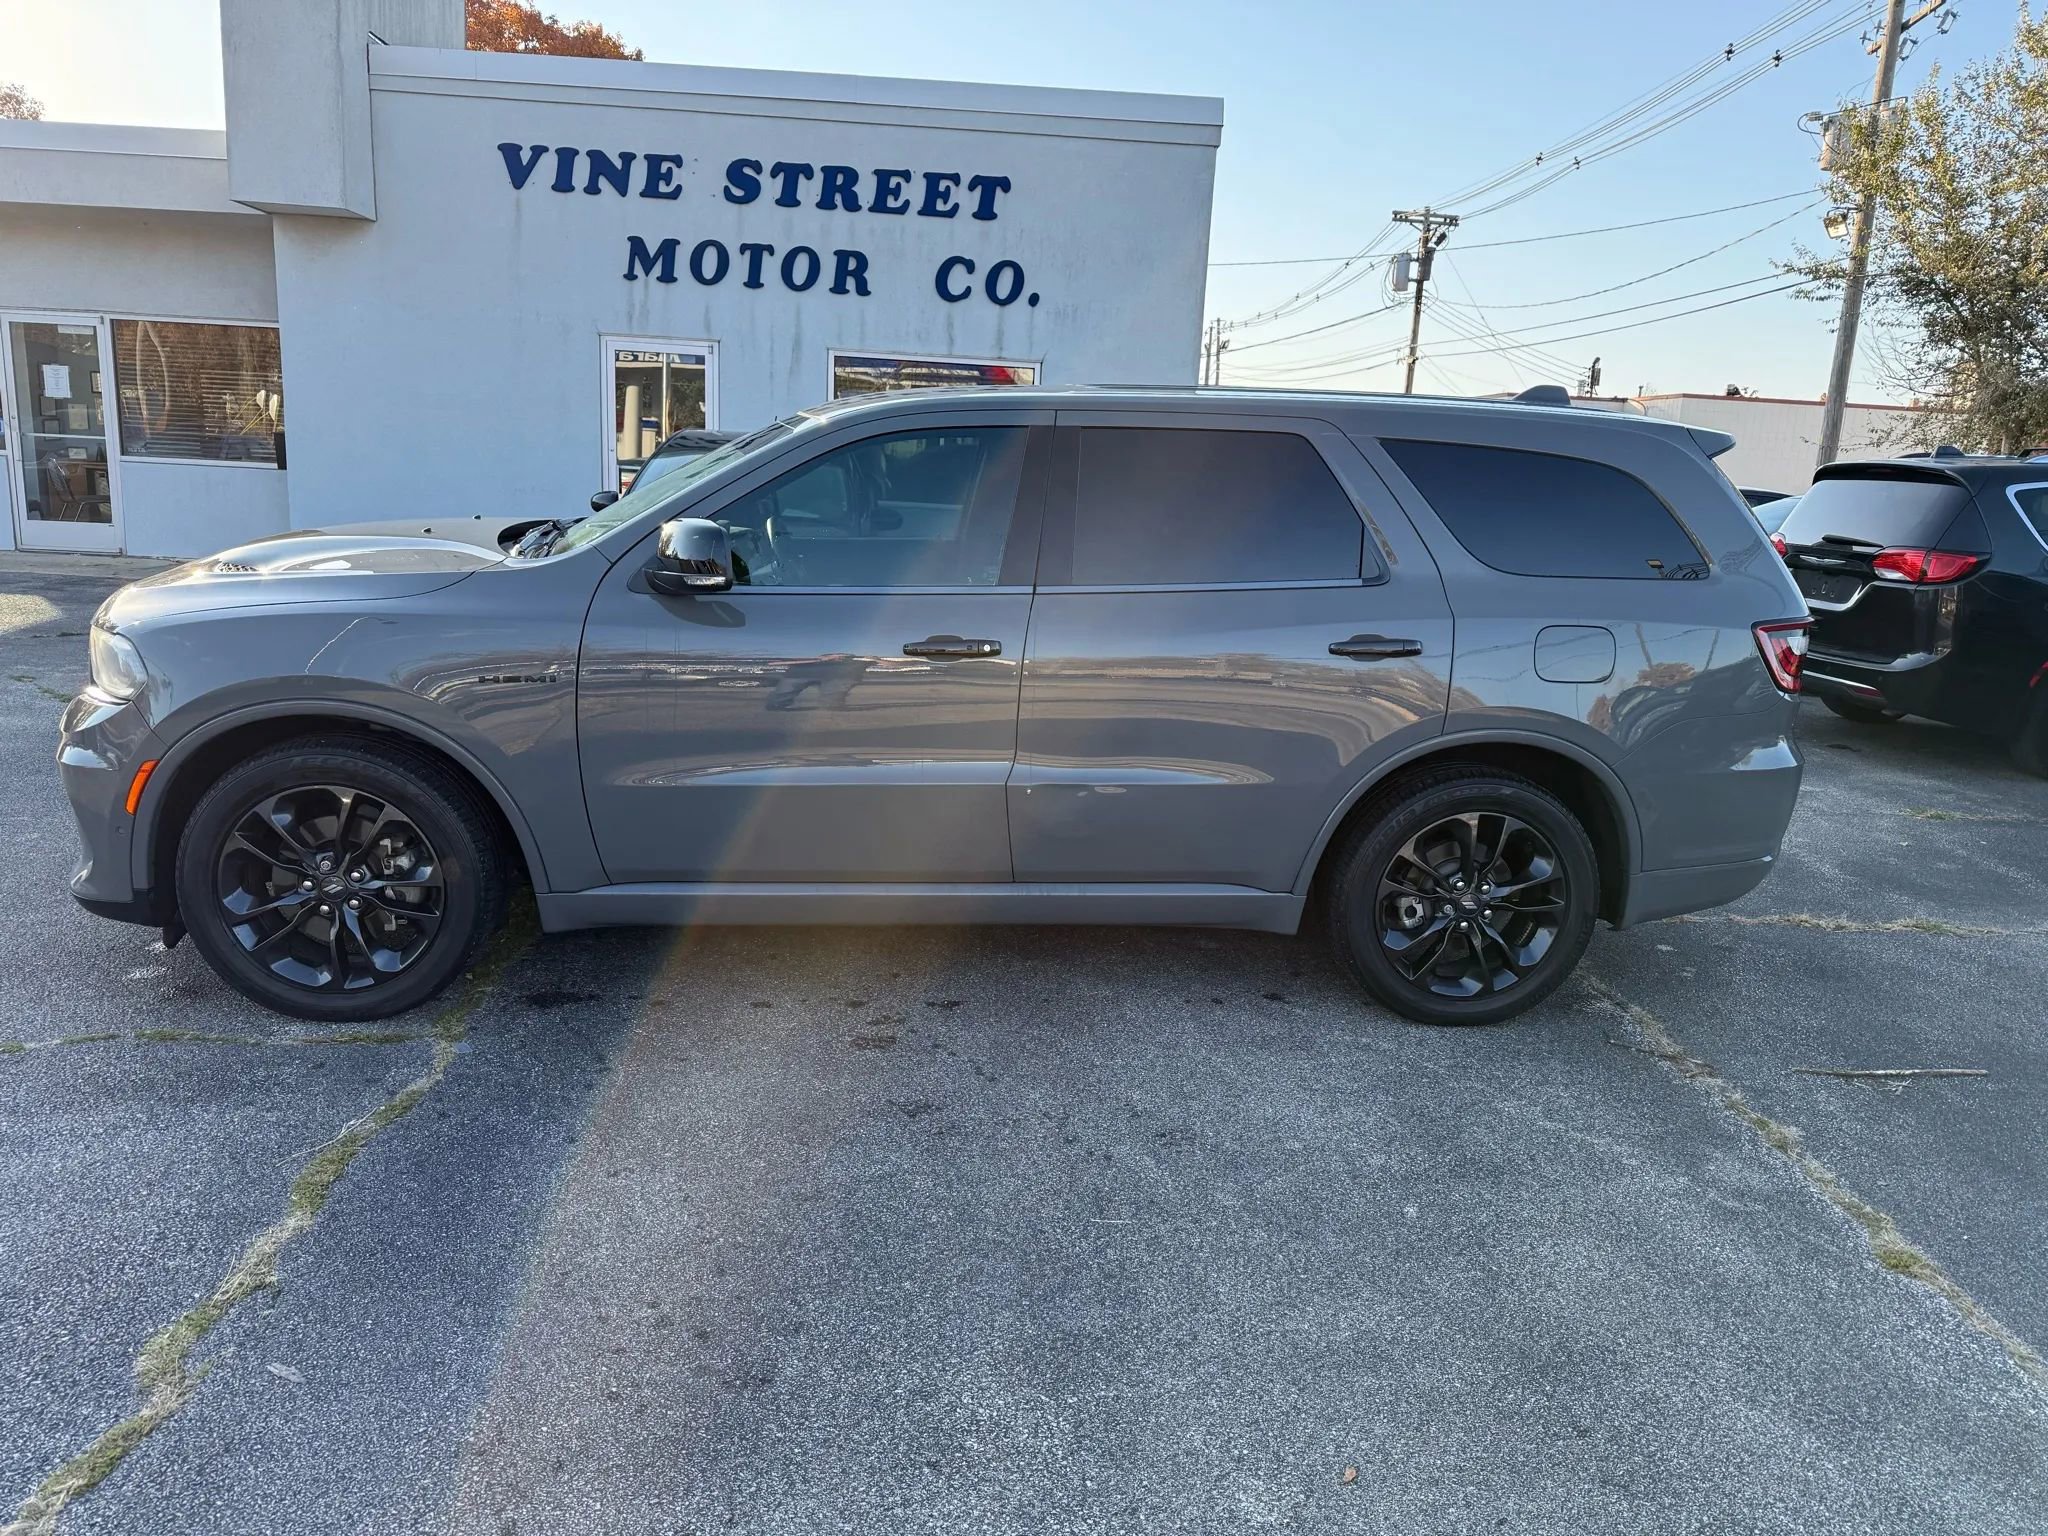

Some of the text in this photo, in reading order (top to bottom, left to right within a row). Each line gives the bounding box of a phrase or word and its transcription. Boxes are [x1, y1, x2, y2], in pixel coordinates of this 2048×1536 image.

[496, 142, 1012, 222] VINE STREET
[622, 235, 1041, 309] MOTOR CO.
[478, 675, 557, 684] HEMI
